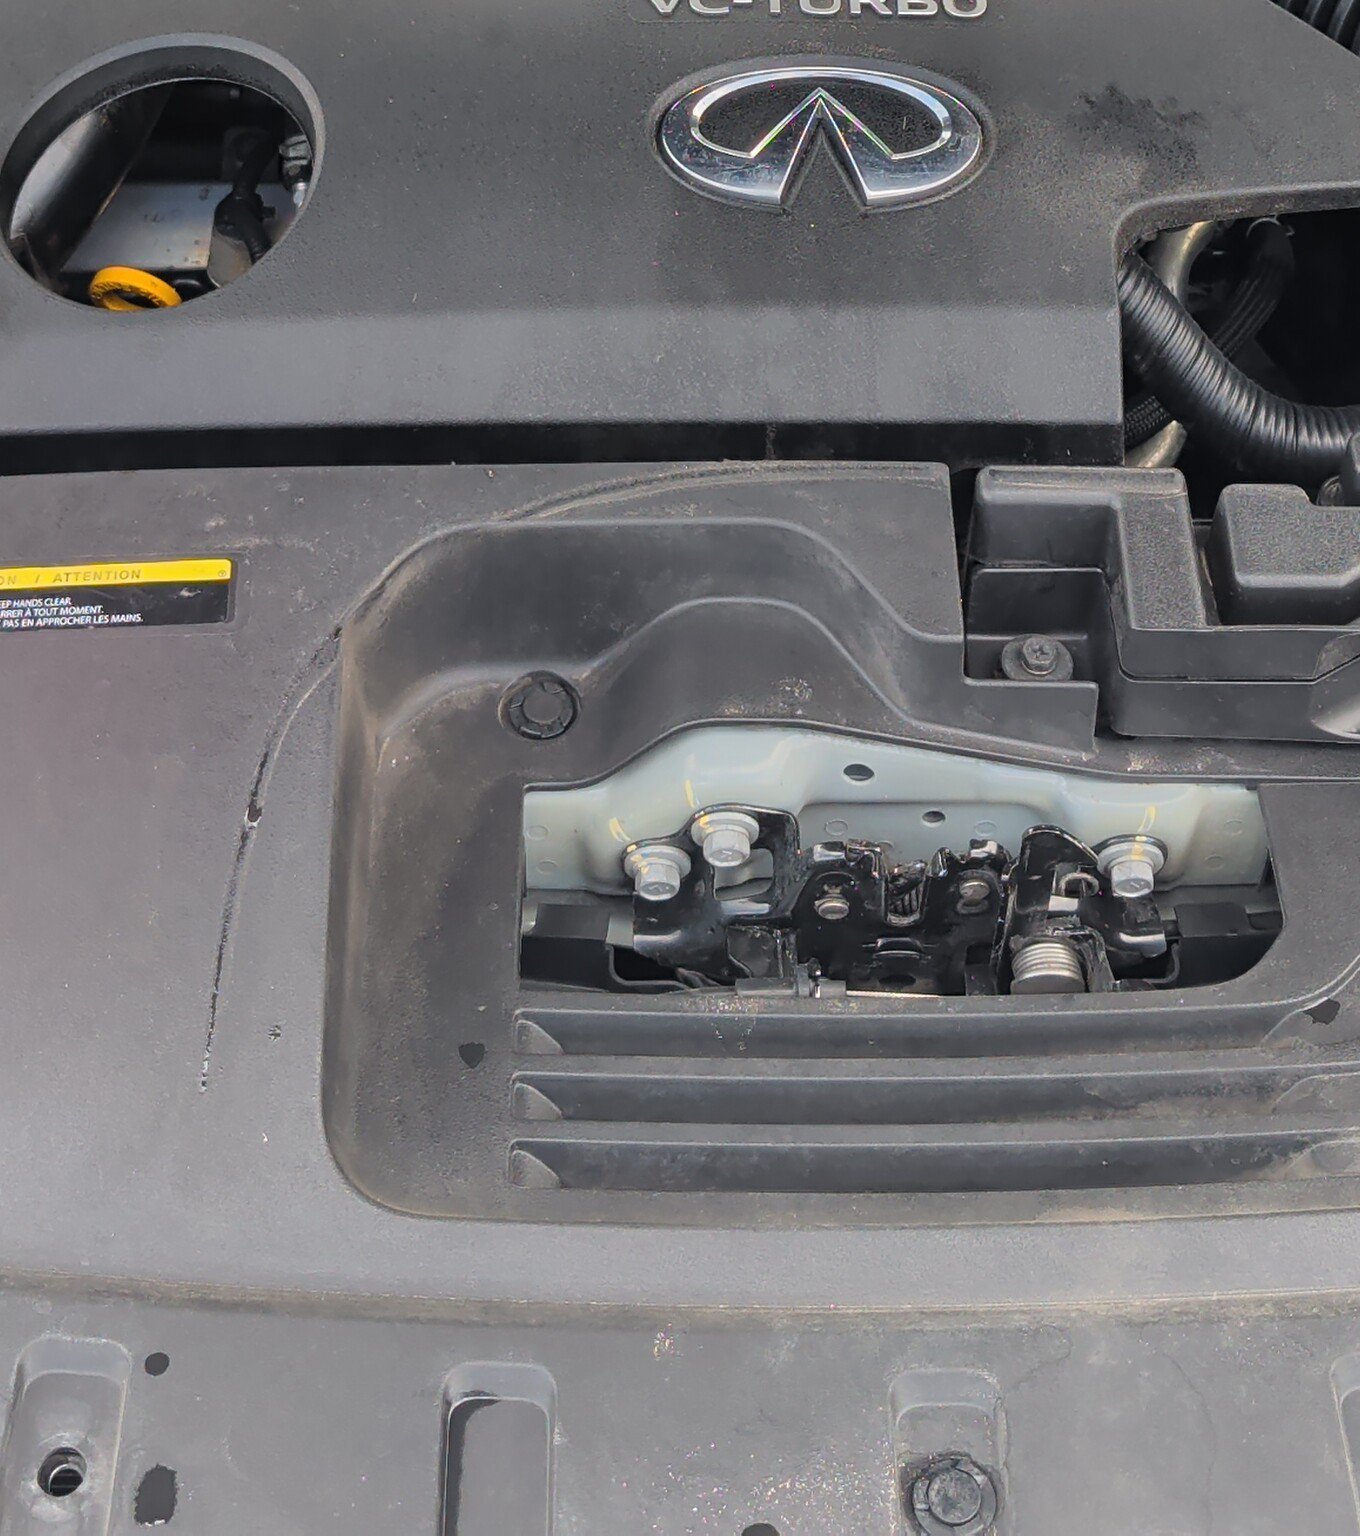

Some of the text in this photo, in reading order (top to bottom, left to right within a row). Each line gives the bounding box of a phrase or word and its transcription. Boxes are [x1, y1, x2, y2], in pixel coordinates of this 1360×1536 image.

[52, 569, 142, 583] ATTENTION
[13, 598, 43, 608] HANDS
[34, 607, 59, 617] TOUT
[59, 604, 104, 615] MOMENT.
[2, 618, 19, 628] PAS
[21, 618, 34, 627] EN
[35, 614, 91, 627] APPROCHER
[93, 614, 109, 624] LES
[110, 613, 143, 624] MAINS.
